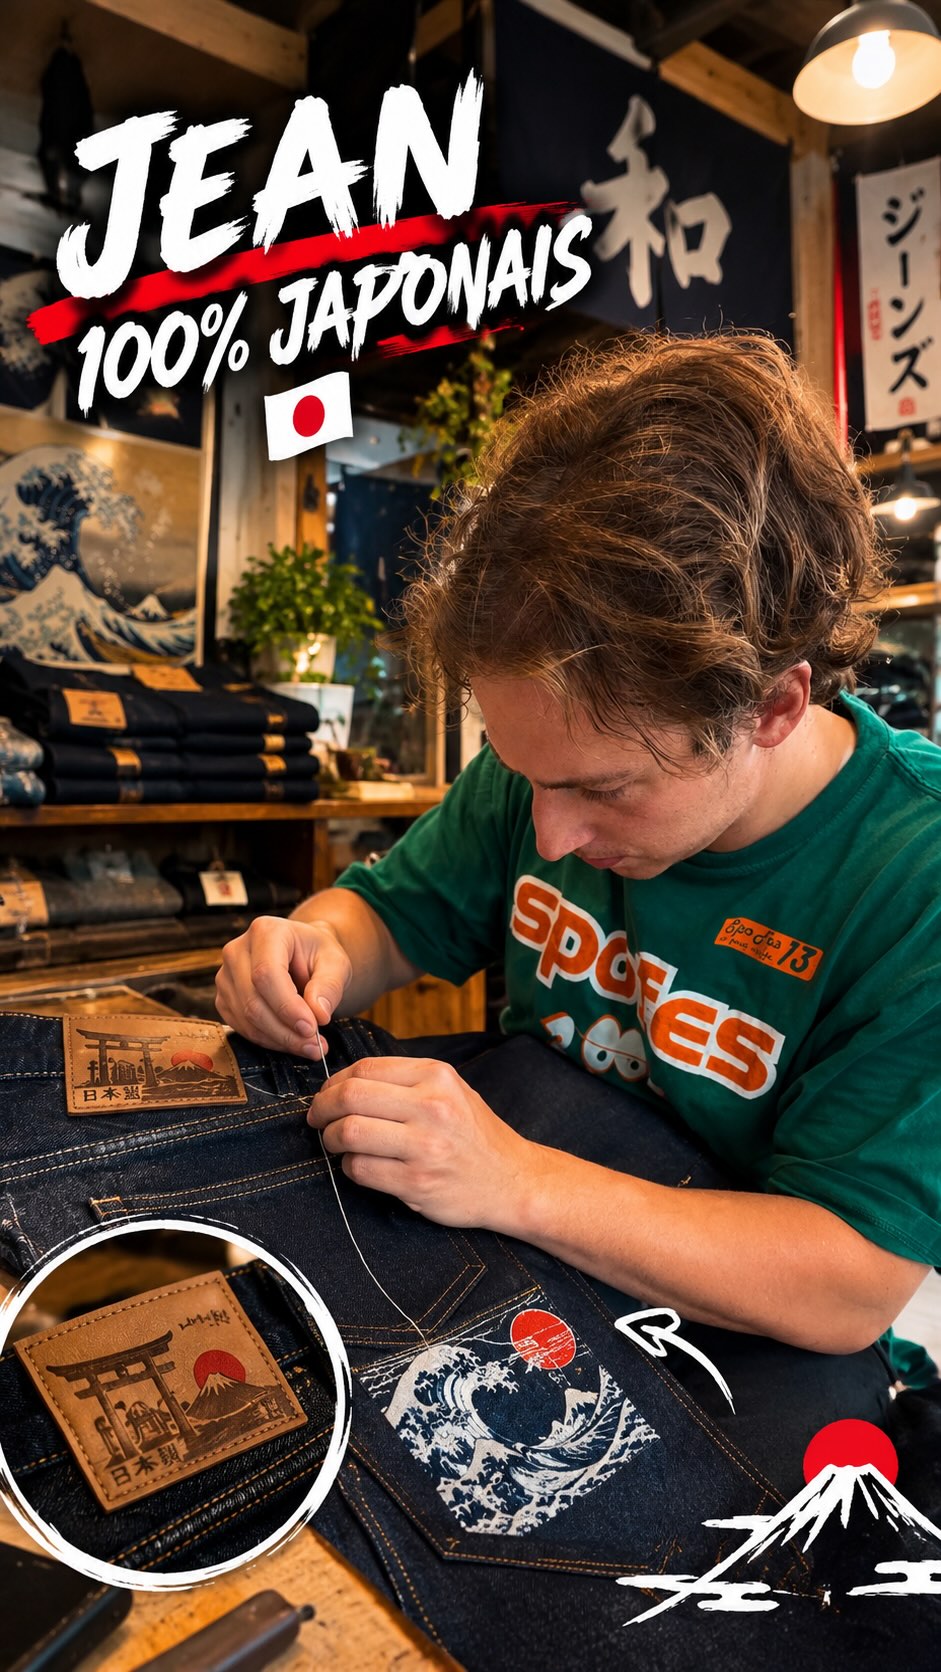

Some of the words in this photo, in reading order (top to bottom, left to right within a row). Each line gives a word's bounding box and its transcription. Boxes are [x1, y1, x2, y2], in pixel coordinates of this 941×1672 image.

[580, 95, 732, 308] 和
[882, 187, 933, 394] ジーンズ
[777, 940, 818, 973] 13
